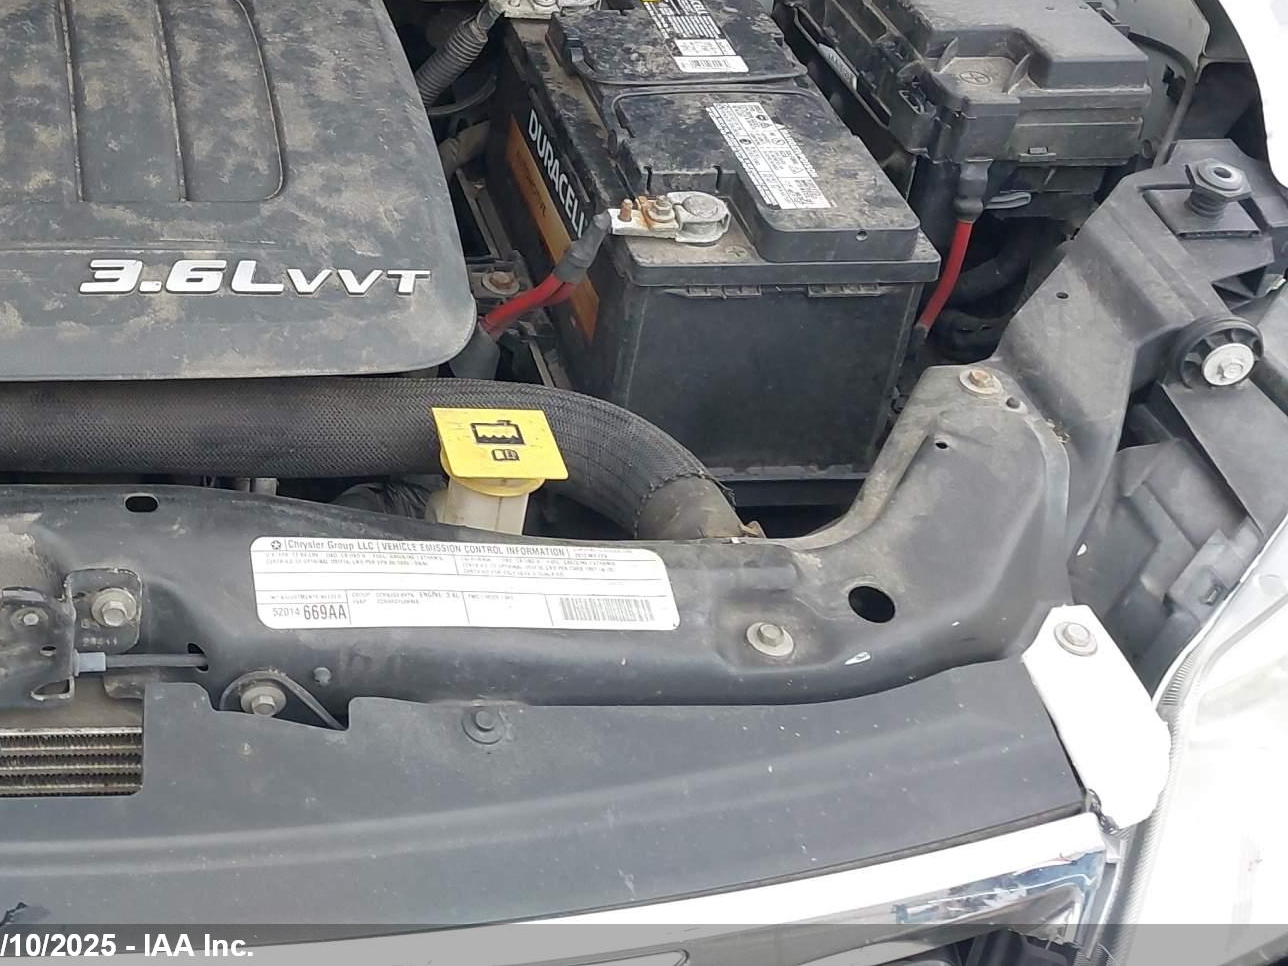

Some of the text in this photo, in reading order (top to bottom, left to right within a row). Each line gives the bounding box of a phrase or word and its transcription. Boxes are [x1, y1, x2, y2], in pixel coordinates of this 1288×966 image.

[288, 539, 374, 552] Chrysler Group LLC
[382, 542, 417, 553] VEHICLE
[419, 543, 462, 554] EMISSION
[464, 545, 504, 555] CONTROL
[506, 546, 566, 557] INFORMATION
[303, 604, 347, 620] 669AA
